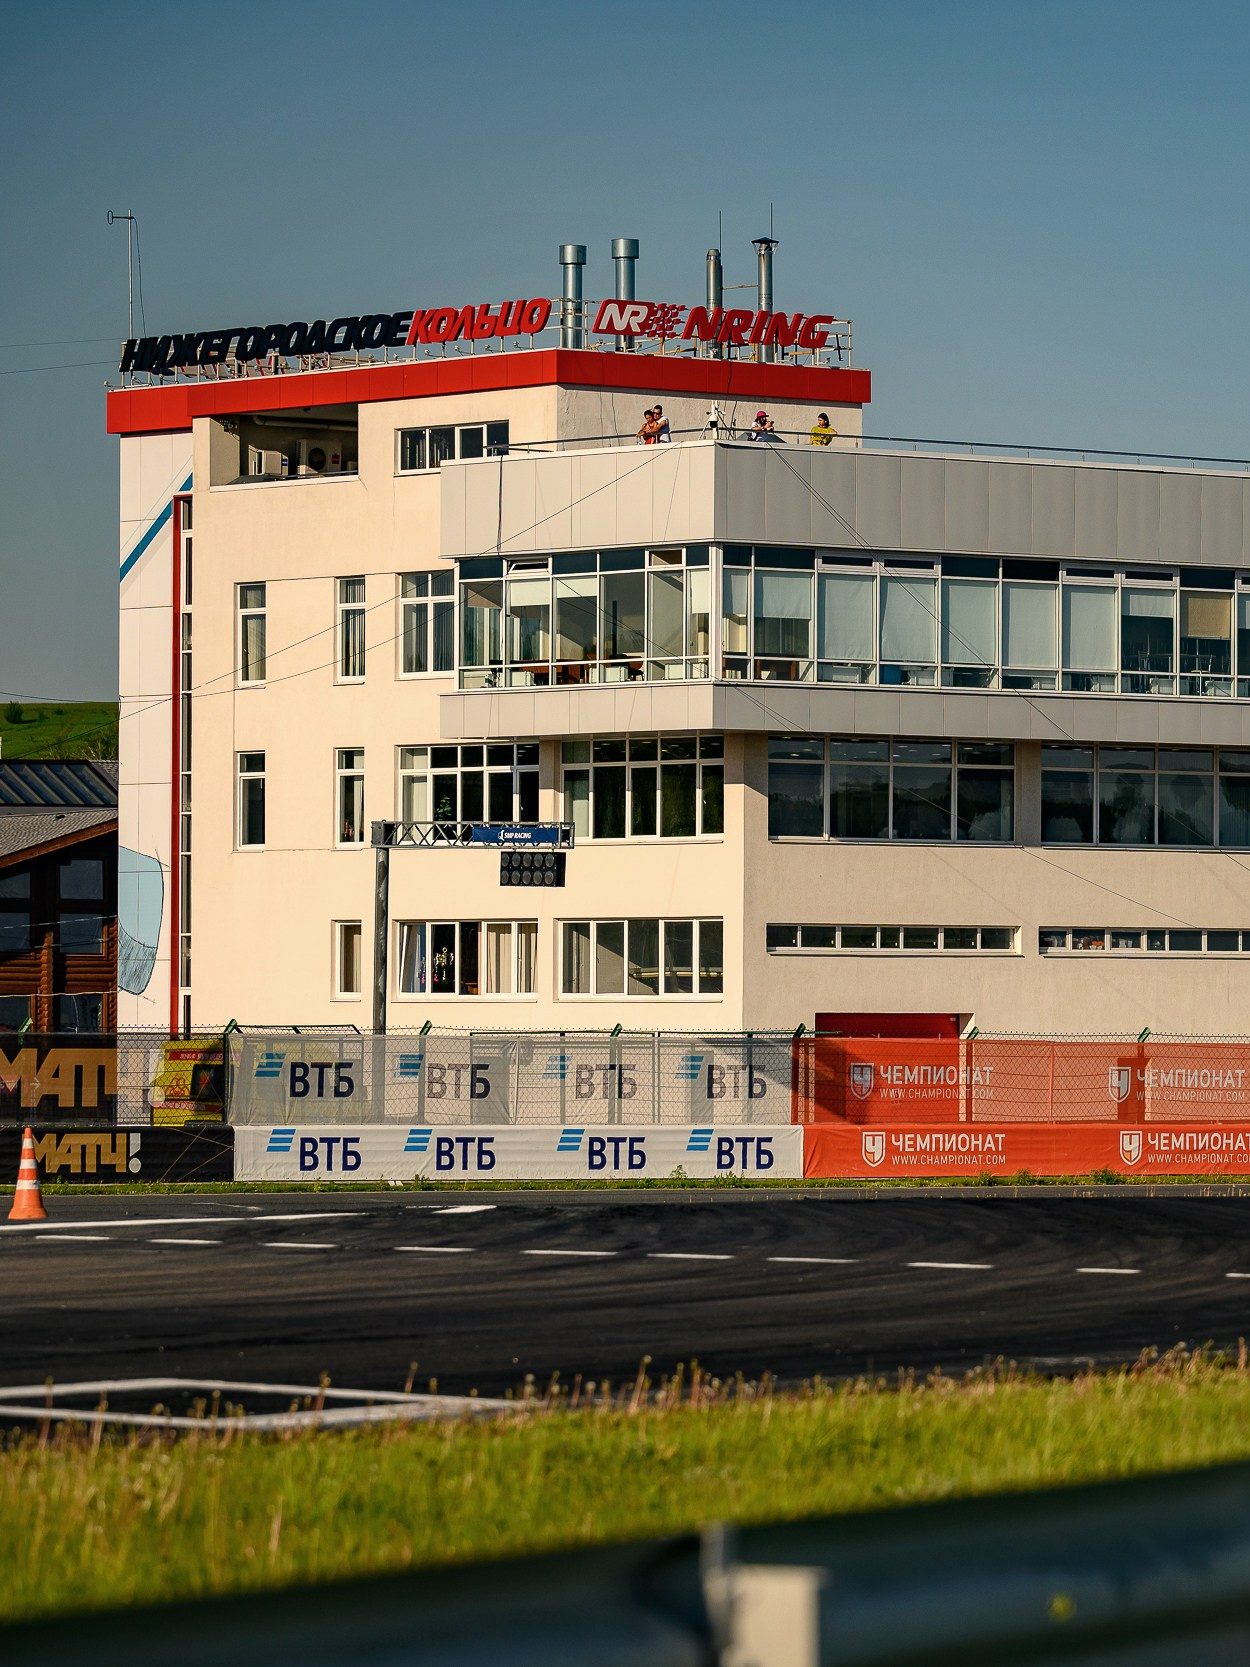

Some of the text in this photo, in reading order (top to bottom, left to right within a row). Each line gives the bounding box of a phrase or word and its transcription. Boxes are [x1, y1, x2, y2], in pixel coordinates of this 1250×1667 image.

[119, 298, 552, 373] НИЖЕГОРОДСКОЕ КОЛЬЦО
[599, 303, 835, 349] NR NRING
[289, 1061, 354, 1098] ВТБ
[427, 1063, 490, 1099] ВТБ
[575, 1064, 637, 1099] ВТБ
[707, 1064, 767, 1099] ВТБ
[879, 1065, 994, 1085] ЧЕМПИОНАТ
[1137, 1069, 1246, 1088] ЧЕМПИОНАТ
[879, 1088, 994, 1099] WWW.CHAMPIONAT.COM
[300, 1137, 361, 1172] ВТБ
[436, 1137, 496, 1171] ВТБ
[588, 1137, 646, 1170] ВТБ
[716, 1137, 774, 1170] ВТБ
[891, 1133, 1006, 1152] ЧЕМПИОНАТ
[891, 1155, 1006, 1165] WWW.CHAMPIONAT.COM
